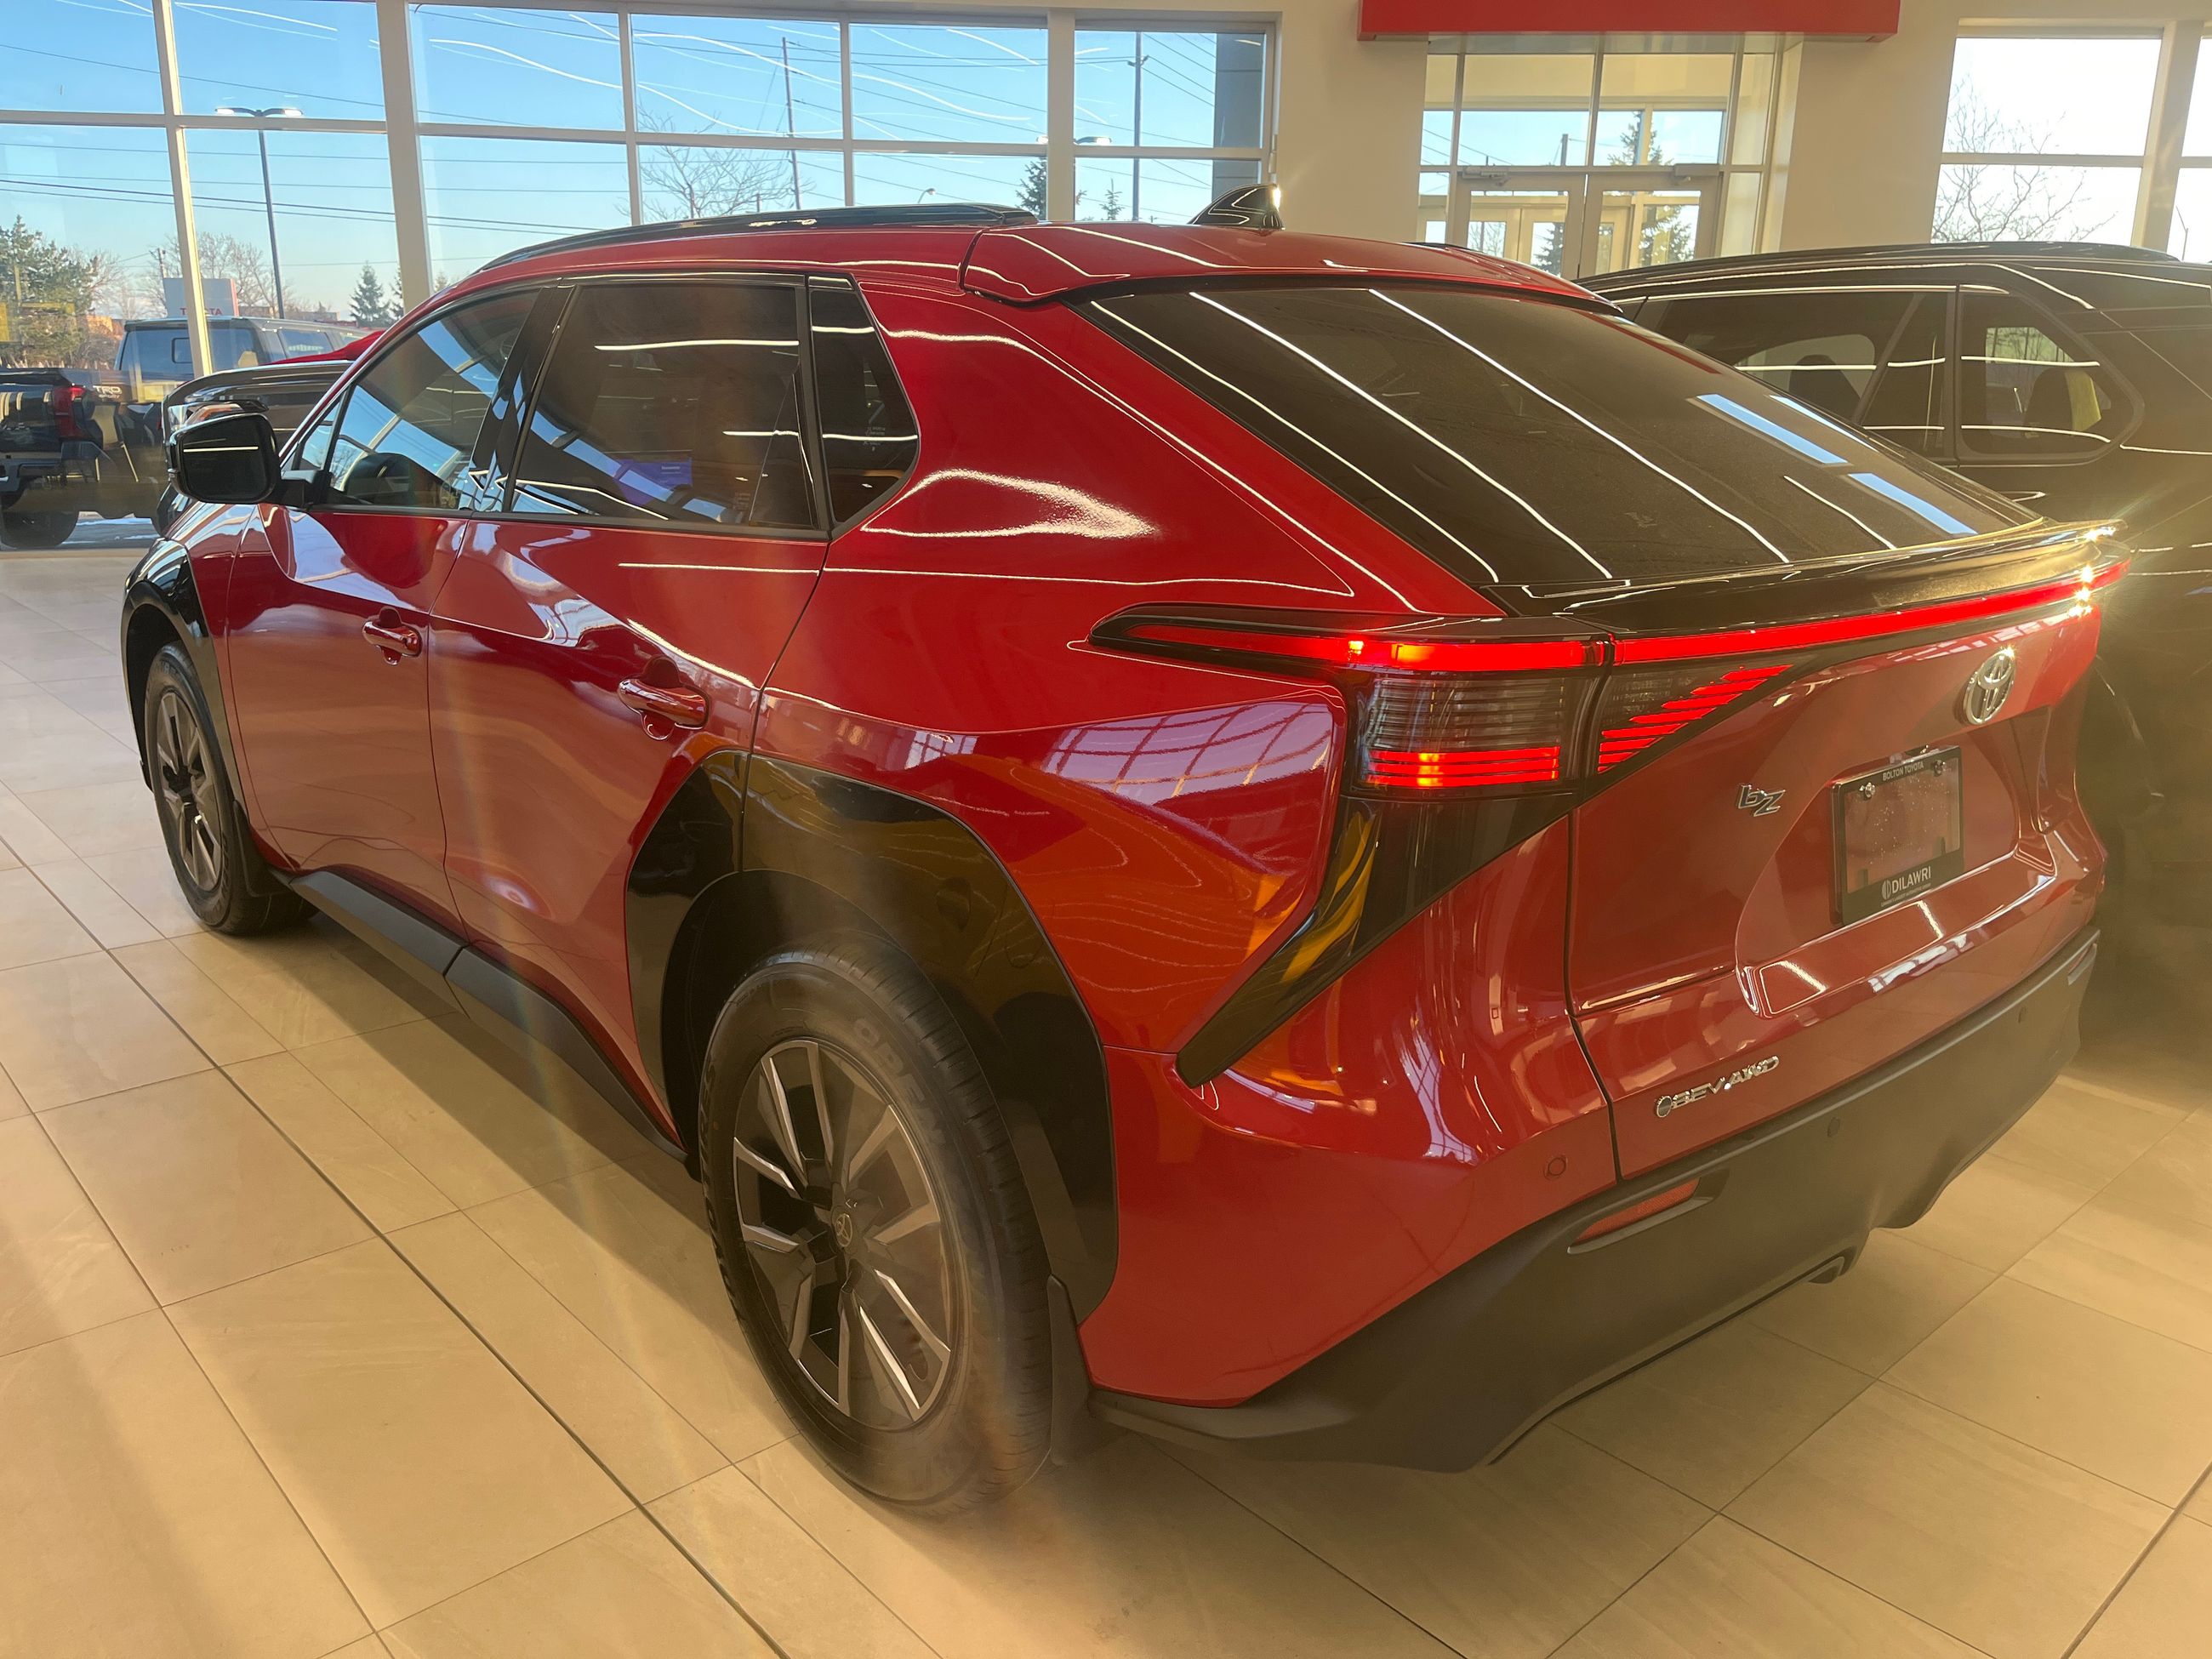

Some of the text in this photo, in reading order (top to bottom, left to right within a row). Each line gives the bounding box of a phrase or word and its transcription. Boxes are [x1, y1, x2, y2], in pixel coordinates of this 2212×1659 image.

[1882, 761, 1924, 781] BOLTON TOYOTA
[1891, 865, 1931, 894] DILAWRI
